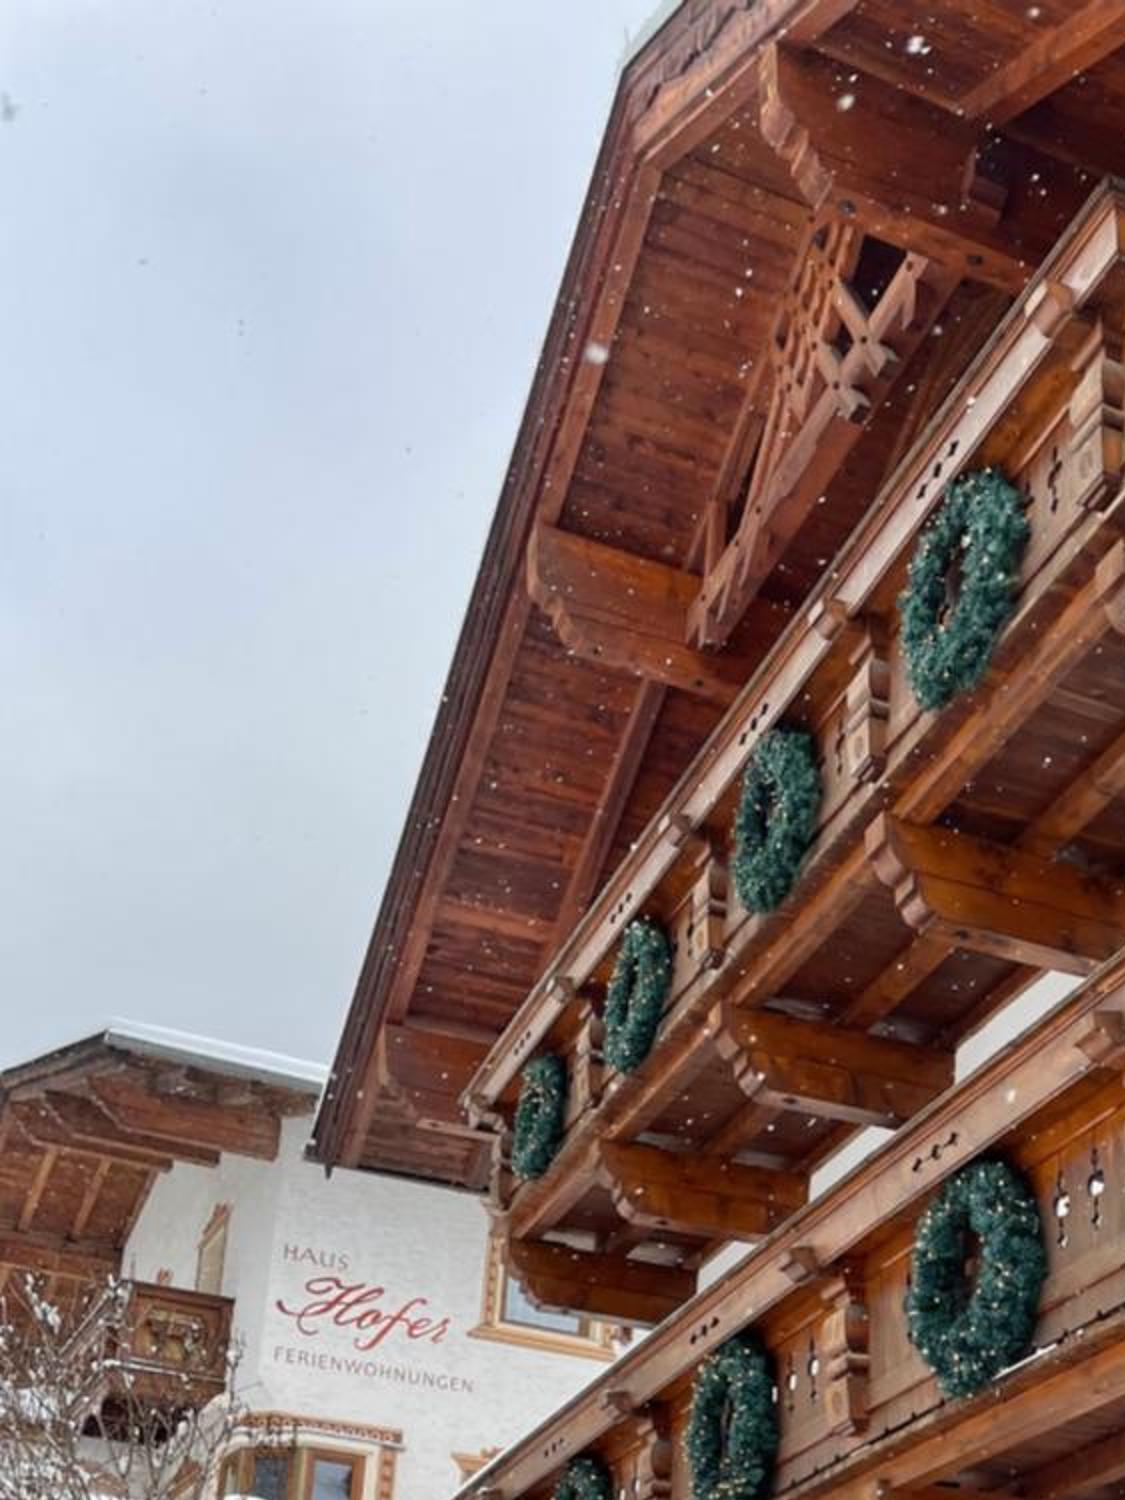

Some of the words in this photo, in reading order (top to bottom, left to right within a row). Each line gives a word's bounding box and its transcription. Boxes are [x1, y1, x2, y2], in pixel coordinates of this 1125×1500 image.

[283, 1244, 350, 1272] HAUS
[275, 1276, 451, 1351] Hofer
[273, 1345, 475, 1394] FERIENWOHNUNGEN
